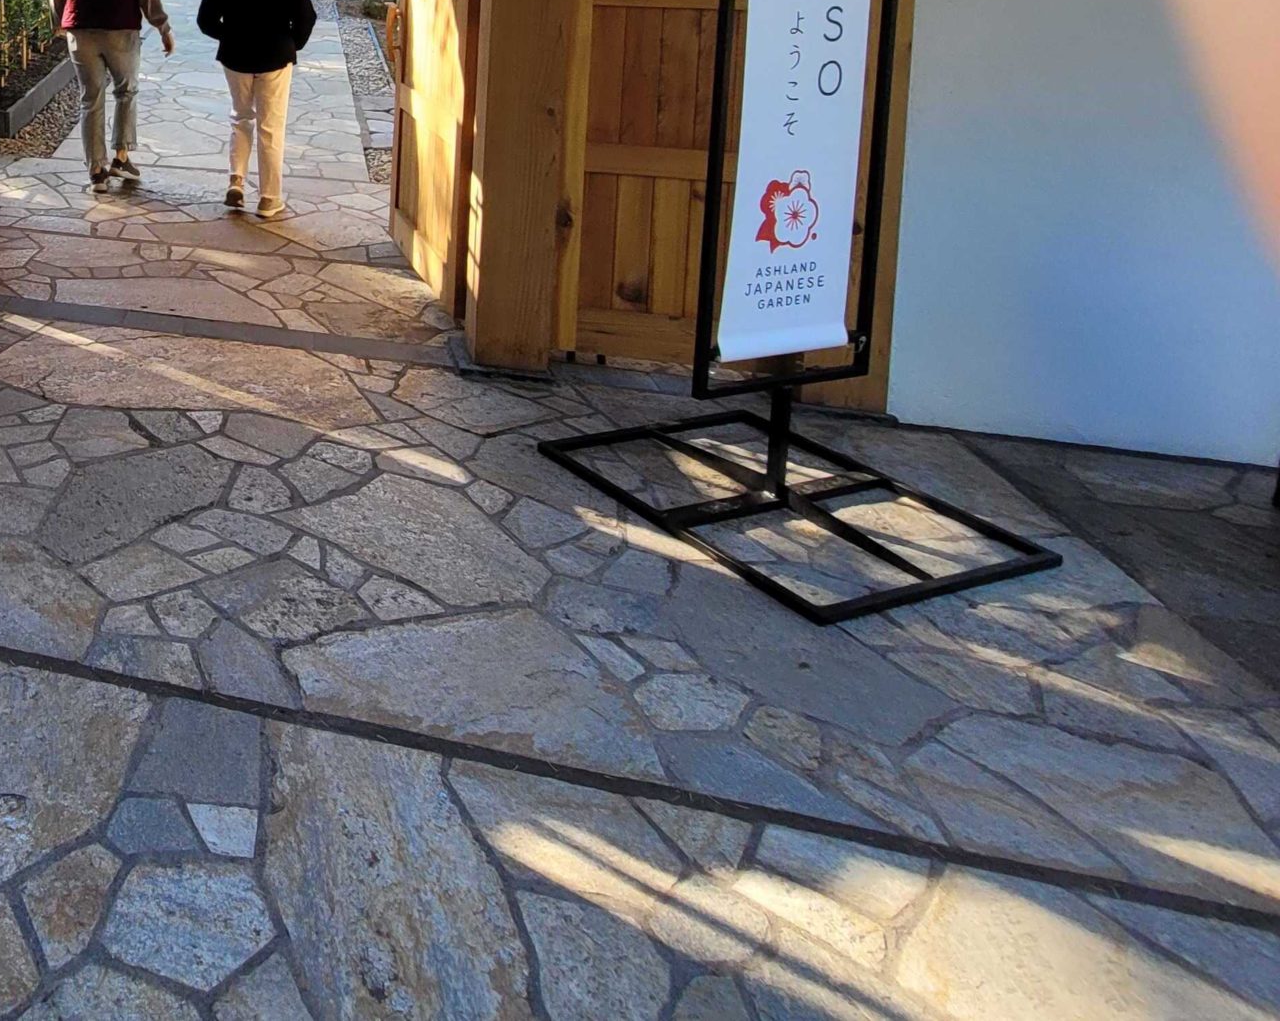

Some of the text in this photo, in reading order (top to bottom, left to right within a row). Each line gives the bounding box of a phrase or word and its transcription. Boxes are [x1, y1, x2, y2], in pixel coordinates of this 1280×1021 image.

[783, 11, 805, 136] ようこそ
[755, 261, 817, 278] ASHLAND
[744, 275, 825, 297] JAPANESE
[757, 294, 812, 310] GARDEN
